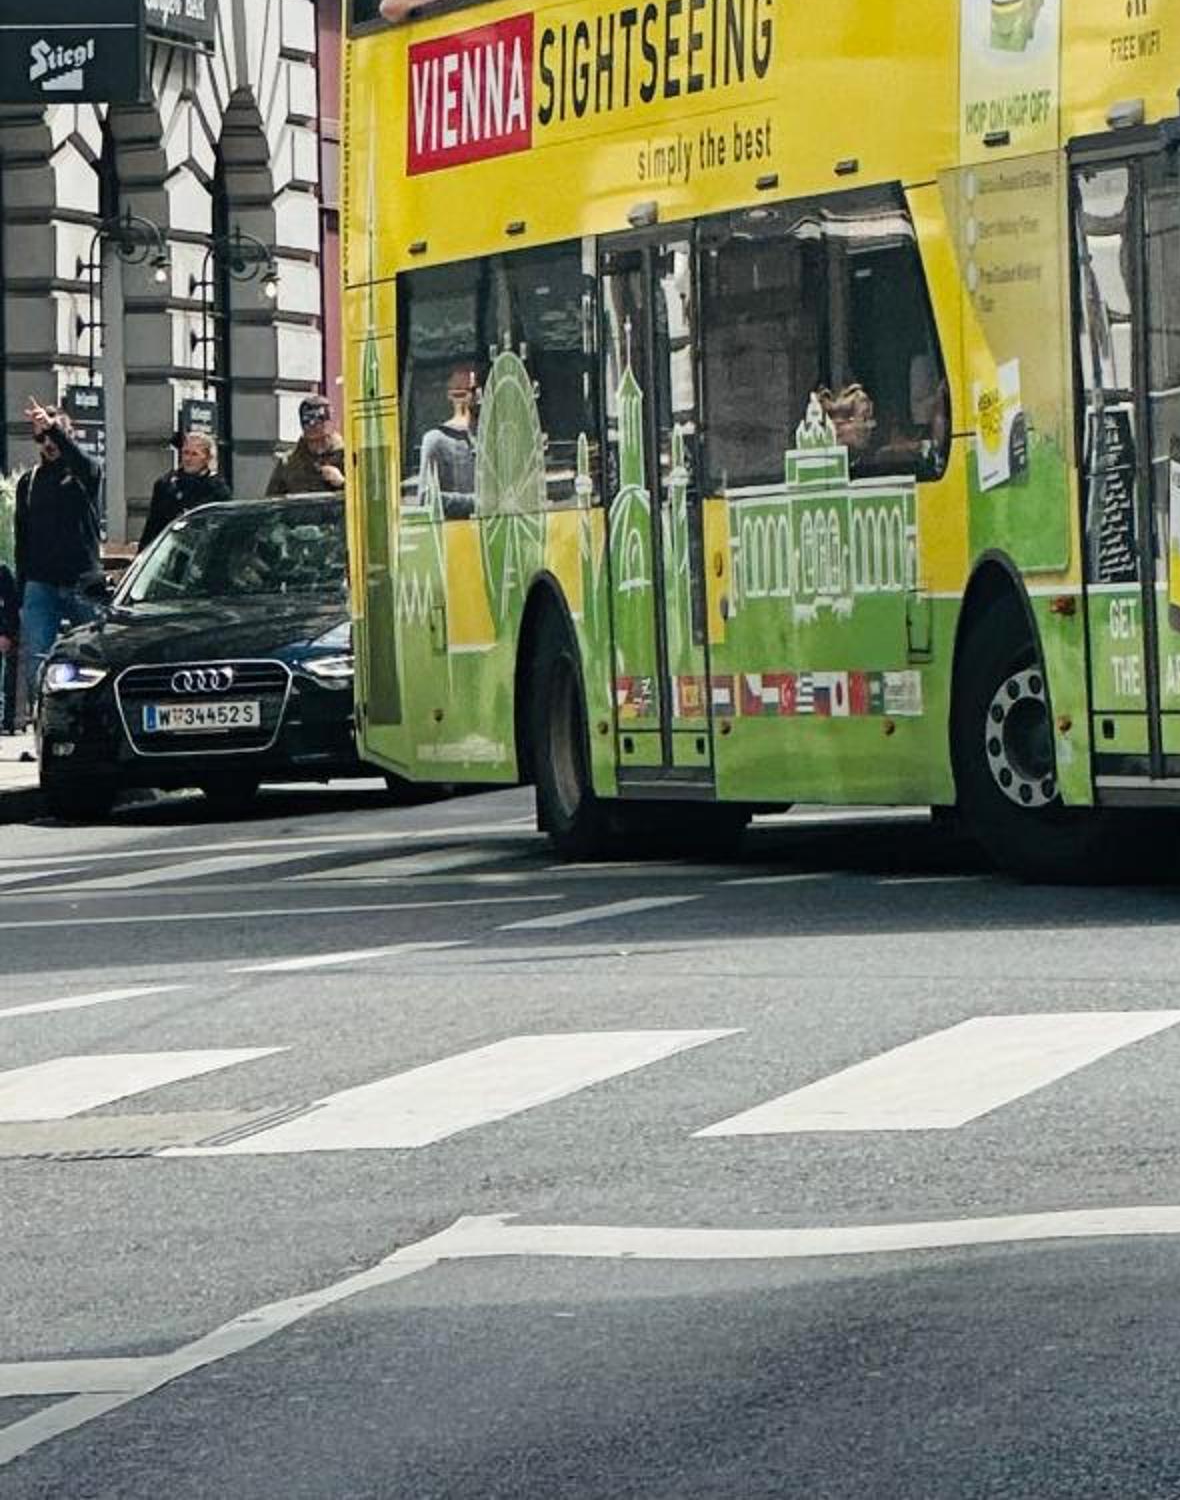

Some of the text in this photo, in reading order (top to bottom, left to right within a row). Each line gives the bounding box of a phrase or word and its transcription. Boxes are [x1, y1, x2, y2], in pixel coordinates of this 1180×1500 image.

[30, 38, 95, 82] Stiegl
[1110, 35, 1137, 63] FREE
[411, 36, 528, 155] VIENNA
[966, 101, 987, 133] HOP
[1006, 94, 1028, 127] HOP
[1029, 89, 1051, 125] OFF
[637, 118, 772, 187] simply the best
[1109, 599, 1138, 639] GET
[1111, 655, 1141, 697] THE
[160, 709, 171, 726] W
